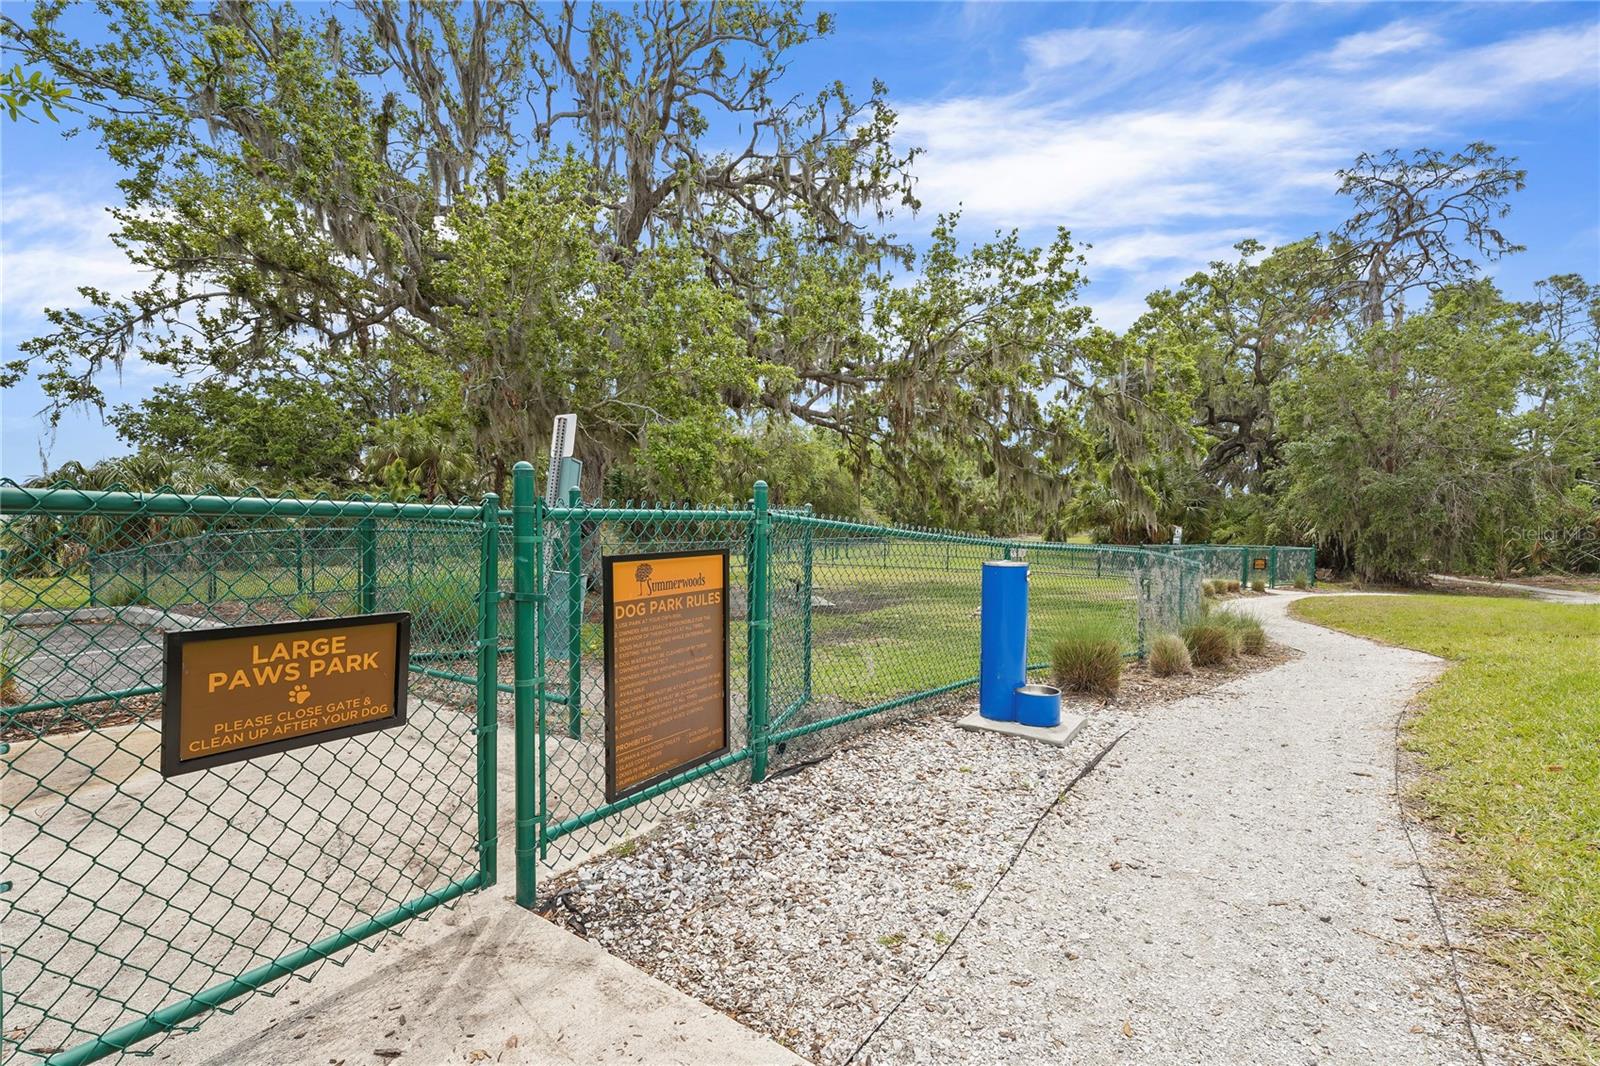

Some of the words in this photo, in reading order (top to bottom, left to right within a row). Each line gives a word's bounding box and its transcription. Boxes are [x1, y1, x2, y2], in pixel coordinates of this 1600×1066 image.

[647, 572, 705, 595] Summerwoods
[616, 602, 646, 619] DOG
[650, 597, 683, 614] PARK
[686, 592, 720, 608] RULES
[252, 636, 347, 664] LARGE
[208, 663, 300, 693] PAWS
[310, 651, 379, 678] PARK
[189, 734, 244, 752] CLEAN
[250, 728, 269, 741] UP
[273, 719, 318, 735] AFTER
[322, 710, 358, 725] YOUR
[362, 704, 388, 718] DOG
[214, 714, 273, 734] PLEASE
[277, 706, 322, 722] CLOSE
[327, 698, 361, 713] GATE
[364, 696, 372, 706] &
